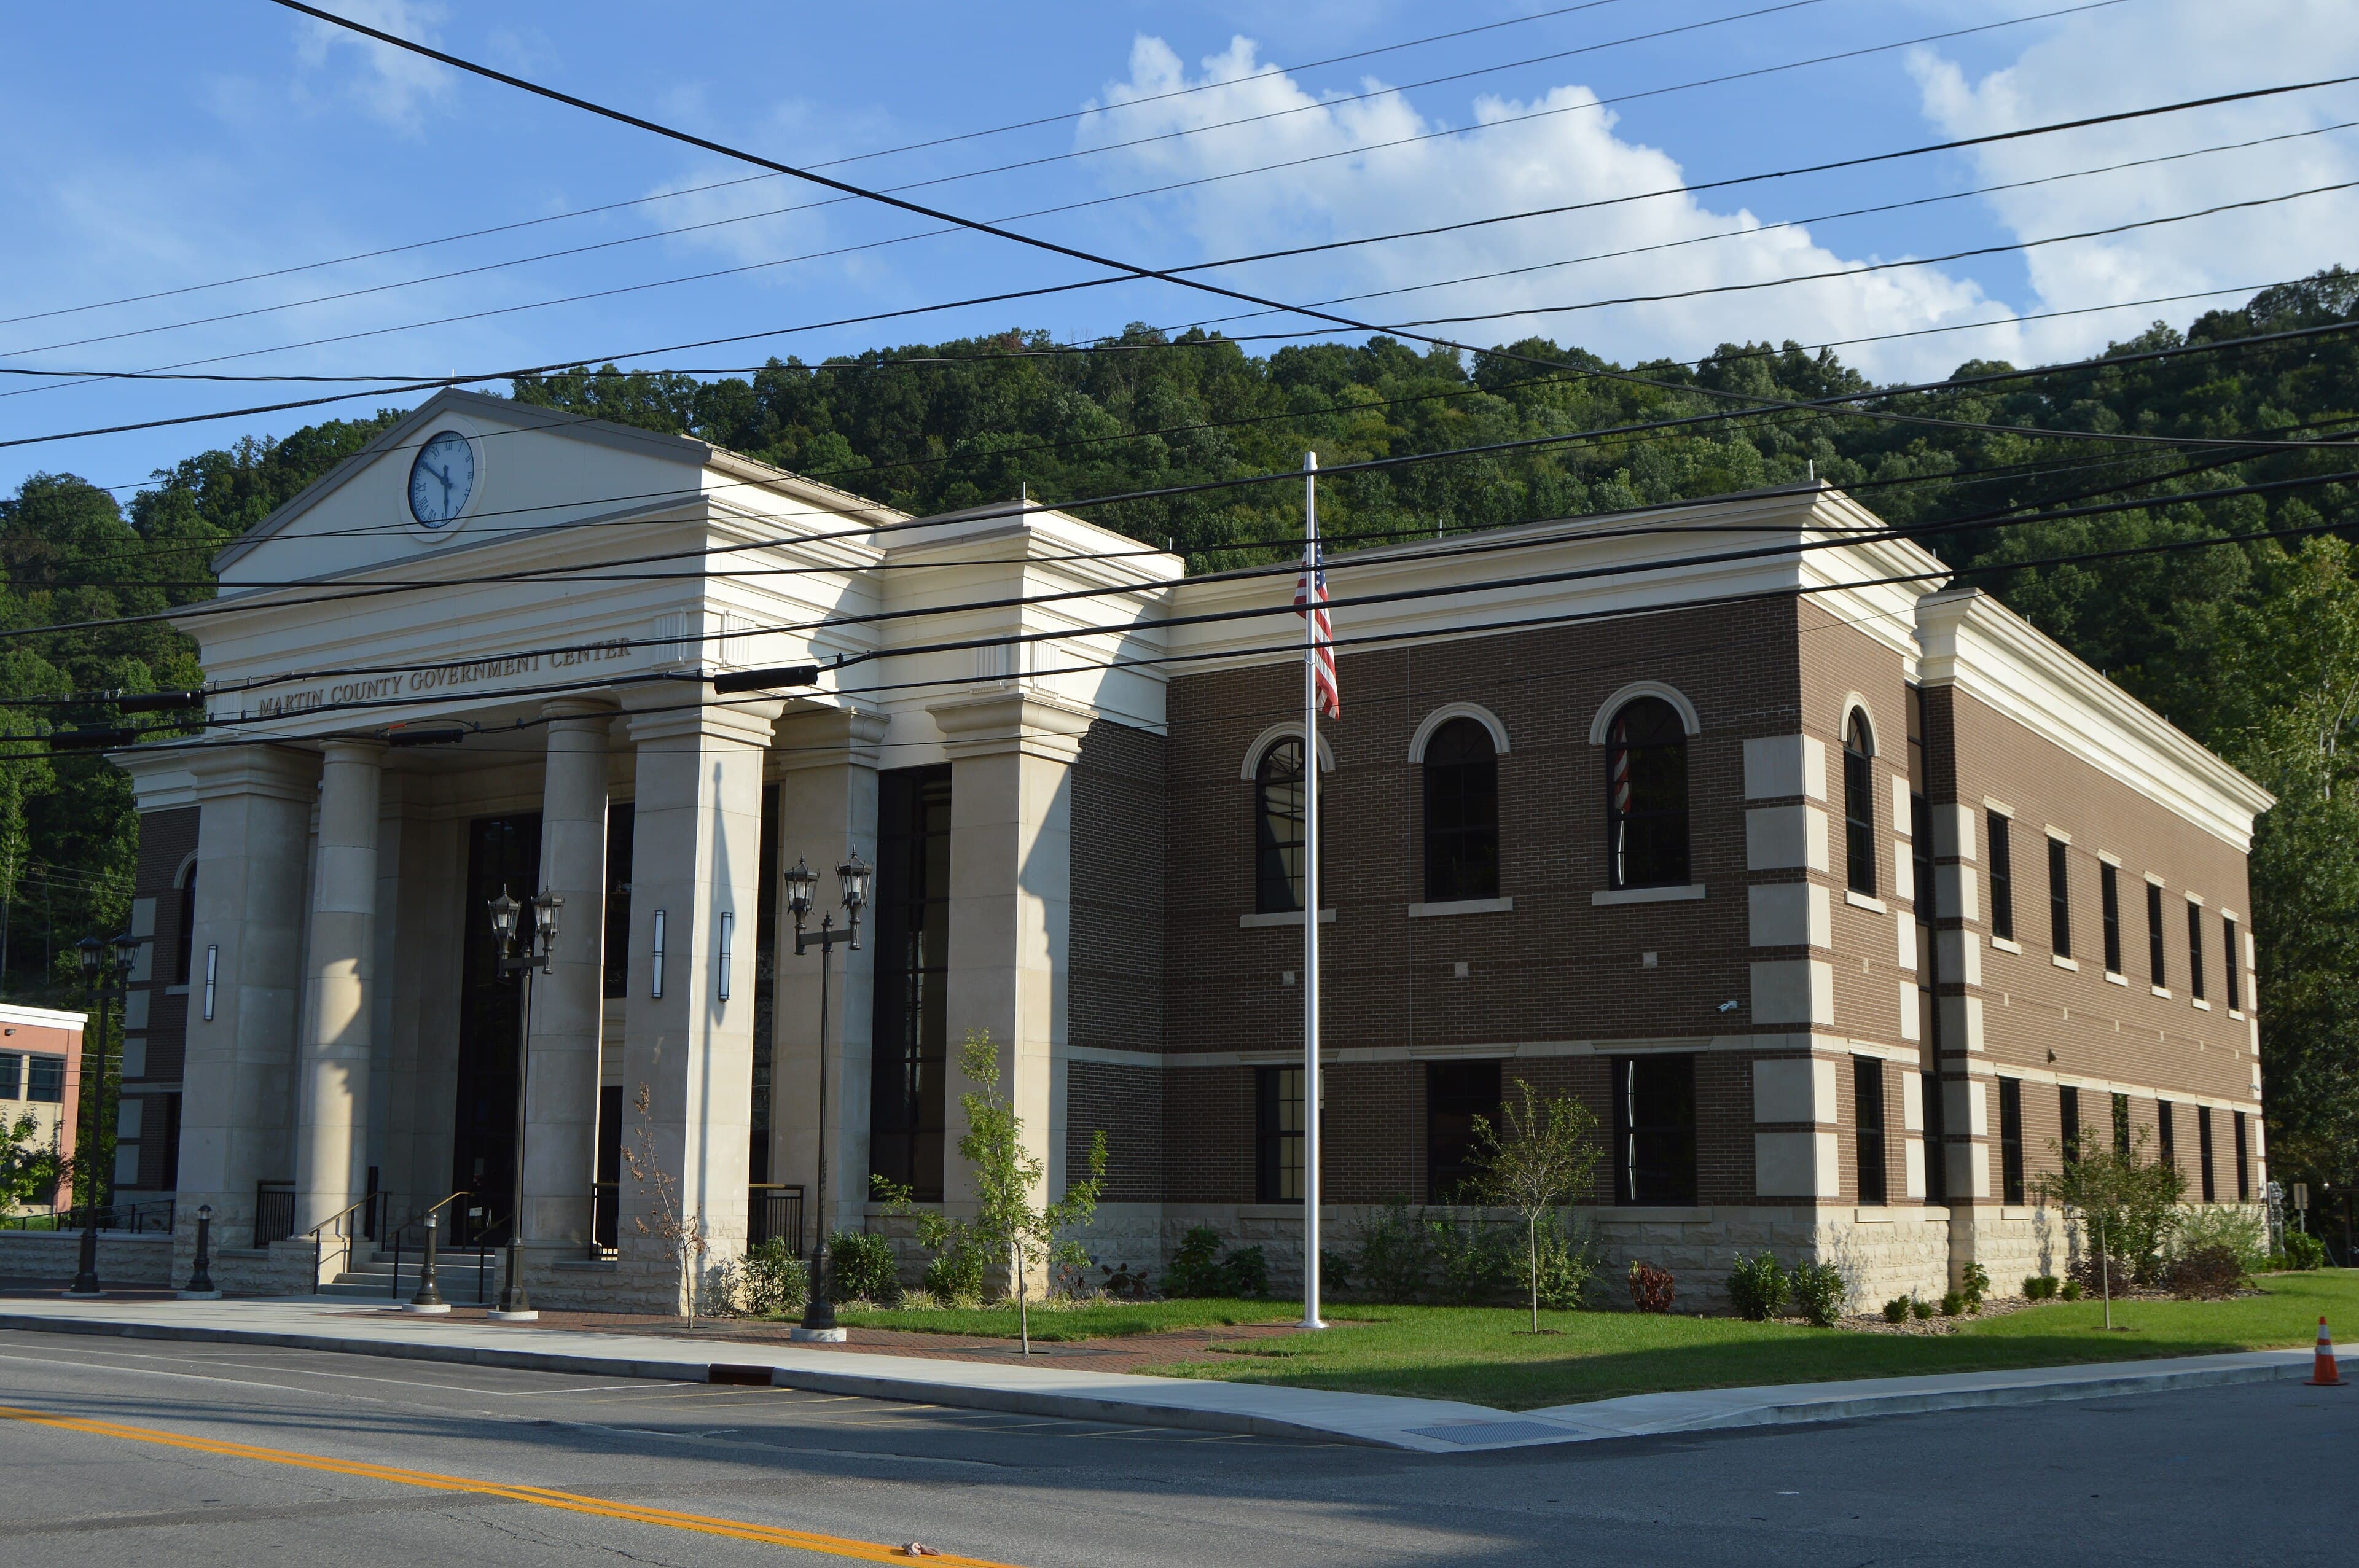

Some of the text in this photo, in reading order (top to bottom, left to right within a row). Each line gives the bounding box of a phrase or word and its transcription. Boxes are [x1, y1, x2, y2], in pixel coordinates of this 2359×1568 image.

[418, 483, 426, 491] IX
[259, 637, 631, 716] MARTIN COUNTY GOVERNMENT CENTER
